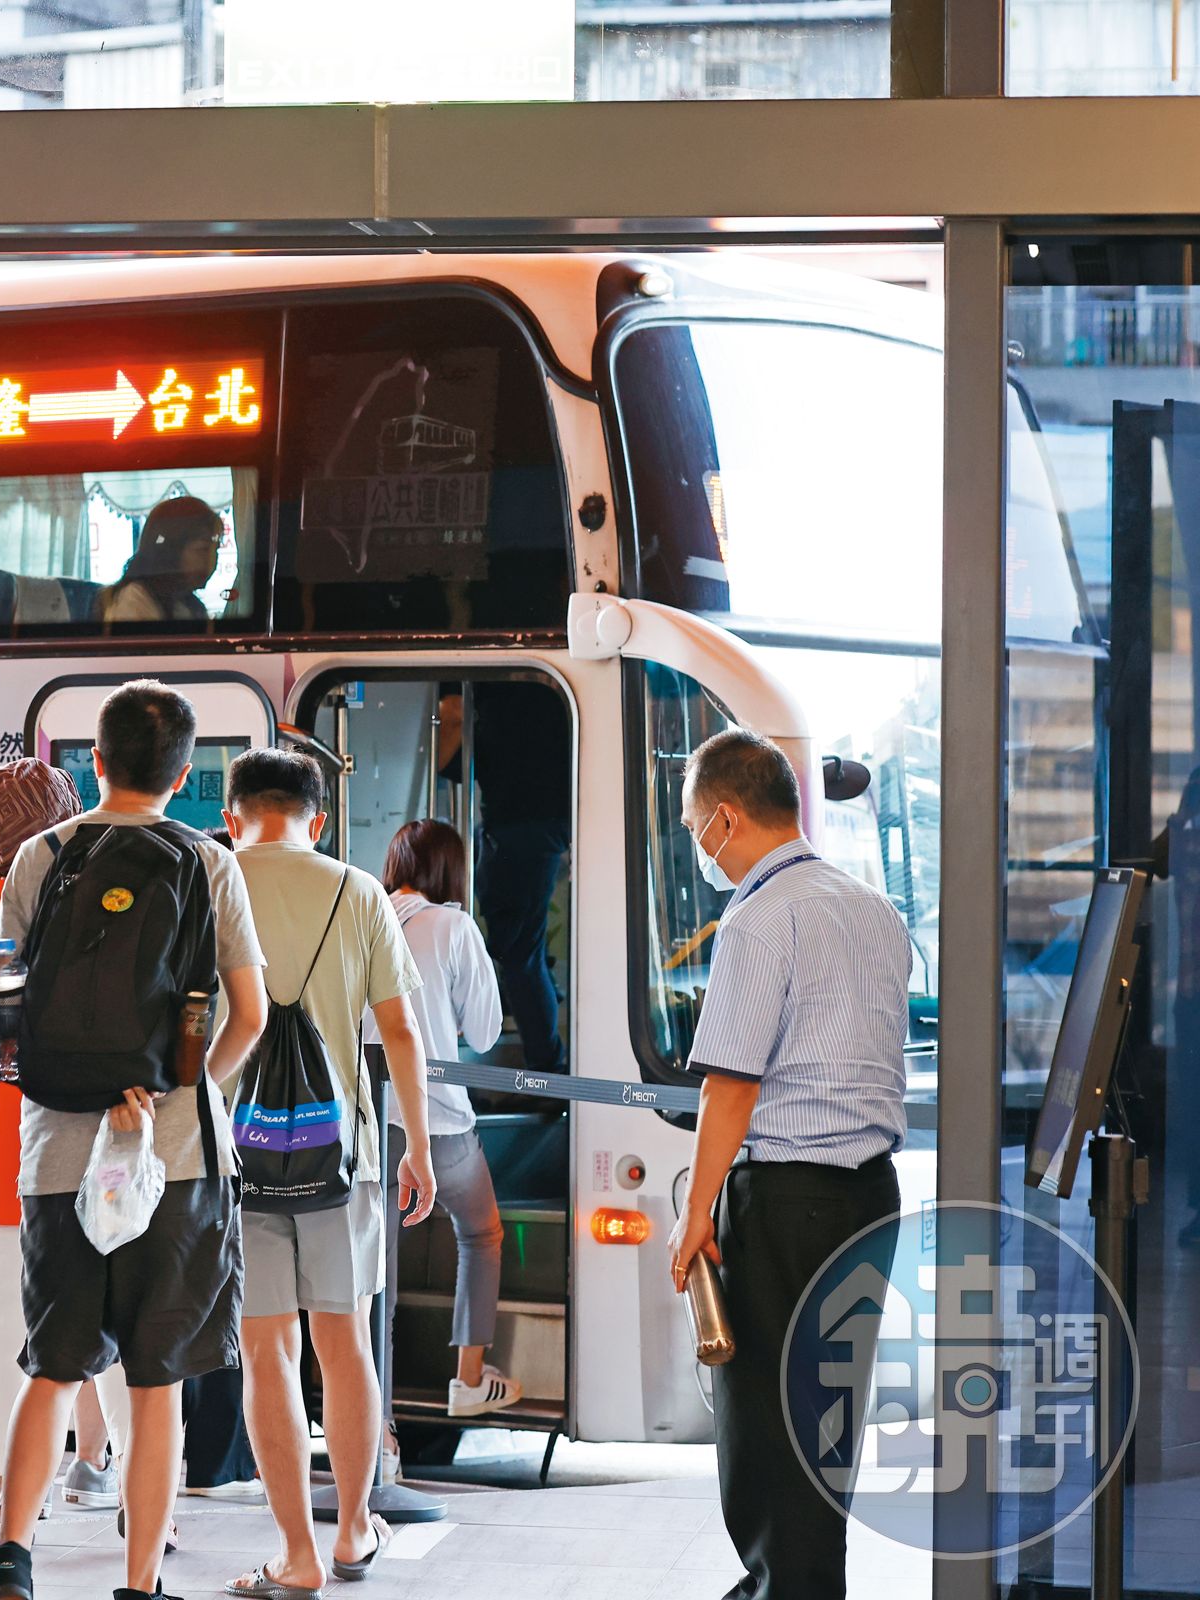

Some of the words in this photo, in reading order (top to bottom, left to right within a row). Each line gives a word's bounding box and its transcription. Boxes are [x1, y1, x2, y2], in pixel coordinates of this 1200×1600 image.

[148, 367, 260, 432] 台北
[261, 1115, 289, 1123] GIAN
[249, 1130, 269, 1143] Liv
